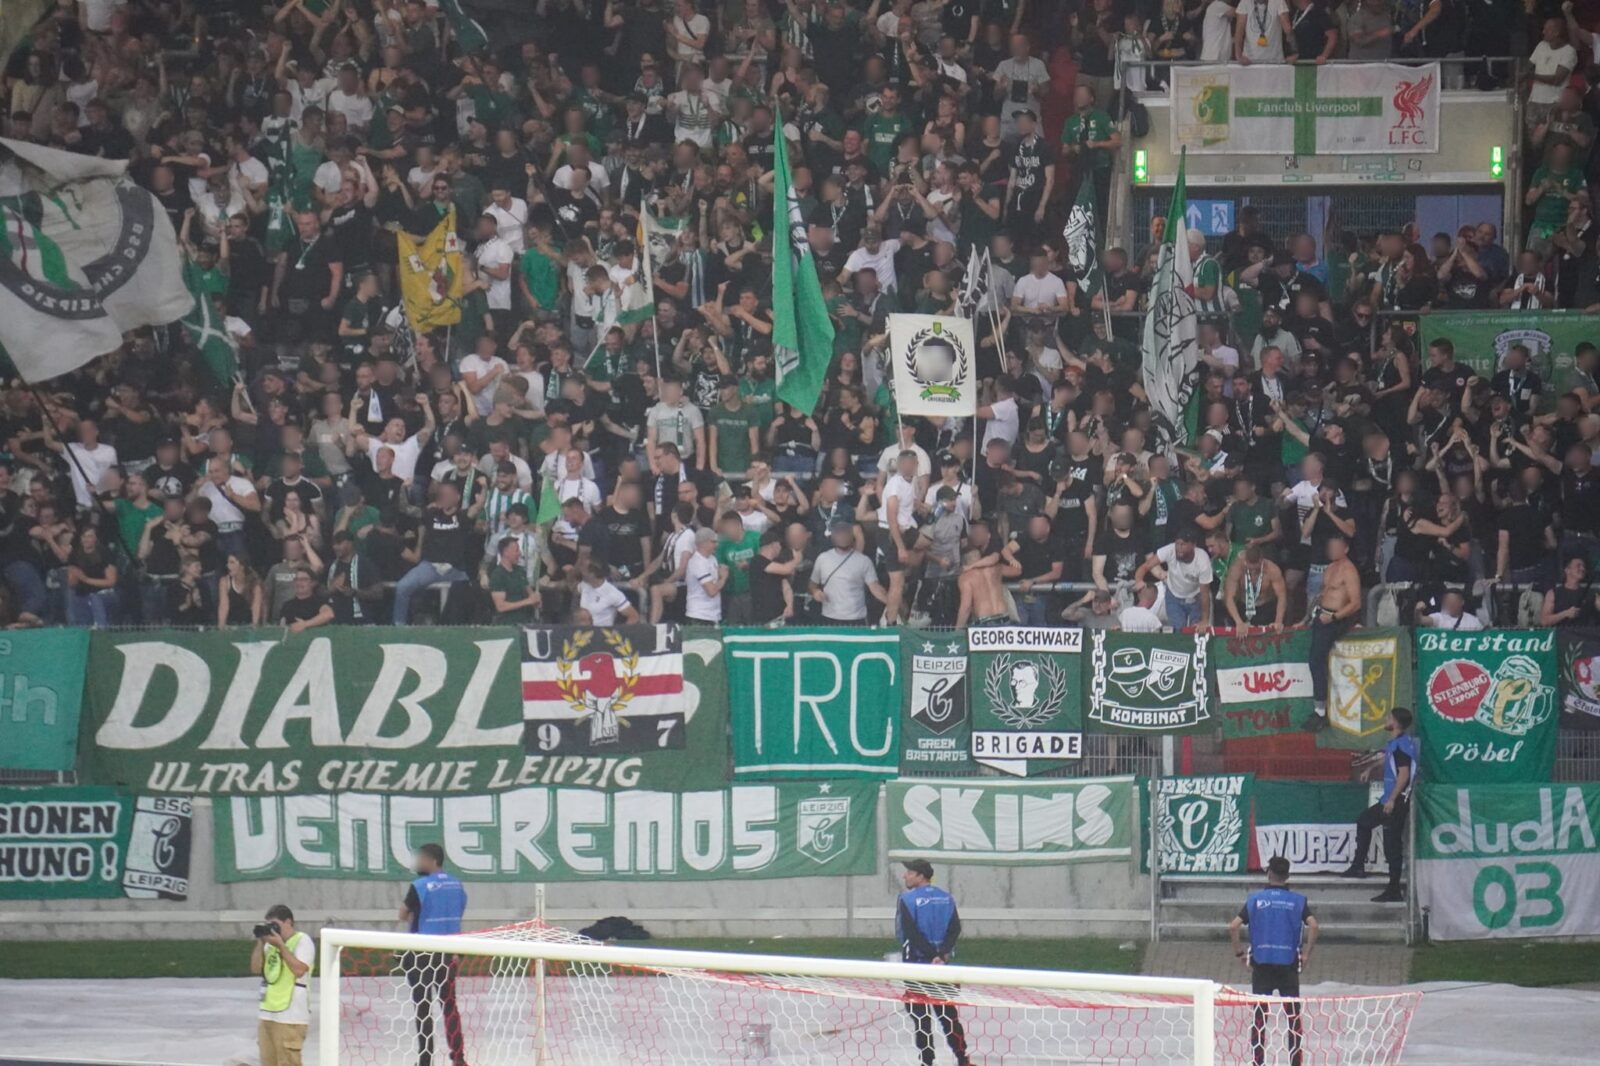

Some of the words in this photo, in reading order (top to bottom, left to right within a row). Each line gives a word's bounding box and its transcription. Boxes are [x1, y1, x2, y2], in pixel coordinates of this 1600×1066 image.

[1257, 102, 1302, 113] Fanclub
[1304, 101, 1361, 115] Liverpool
[1388, 130, 1428, 146] L.F.C.
[523, 629, 553, 660] U
[652, 623, 681, 654] F
[971, 629, 1014, 647] GEORG
[1016, 630, 1081, 648] SCHWARZ
[915, 658, 965, 671] LEIPZIG
[1154, 653, 1185, 664] LEIPZIG
[1433, 673, 1488, 704] STERNBURG
[1449, 686, 1481, 707] EXPORT
[731, 650, 896, 756] TRC
[1110, 708, 1187, 726] KOMBINAT
[537, 723, 561, 751] 9
[656, 719, 678, 748] 7
[918, 738, 956, 750] GREEN
[975, 733, 1080, 755] BRIGADE
[905, 749, 968, 762] BASTARDS
[1444, 740, 1525, 763] Pöbel
[147, 760, 302, 792] ULTRAS
[317, 759, 477, 792] CHEMIE
[487, 755, 644, 789] LEIPZIG
[153, 797, 193, 814] BSG
[801, 802, 845, 812] LEIPZIG
[902, 783, 1115, 851] SKINS
[128, 874, 189, 894] LEIPZIG
[1472, 860, 1565, 930] 03
